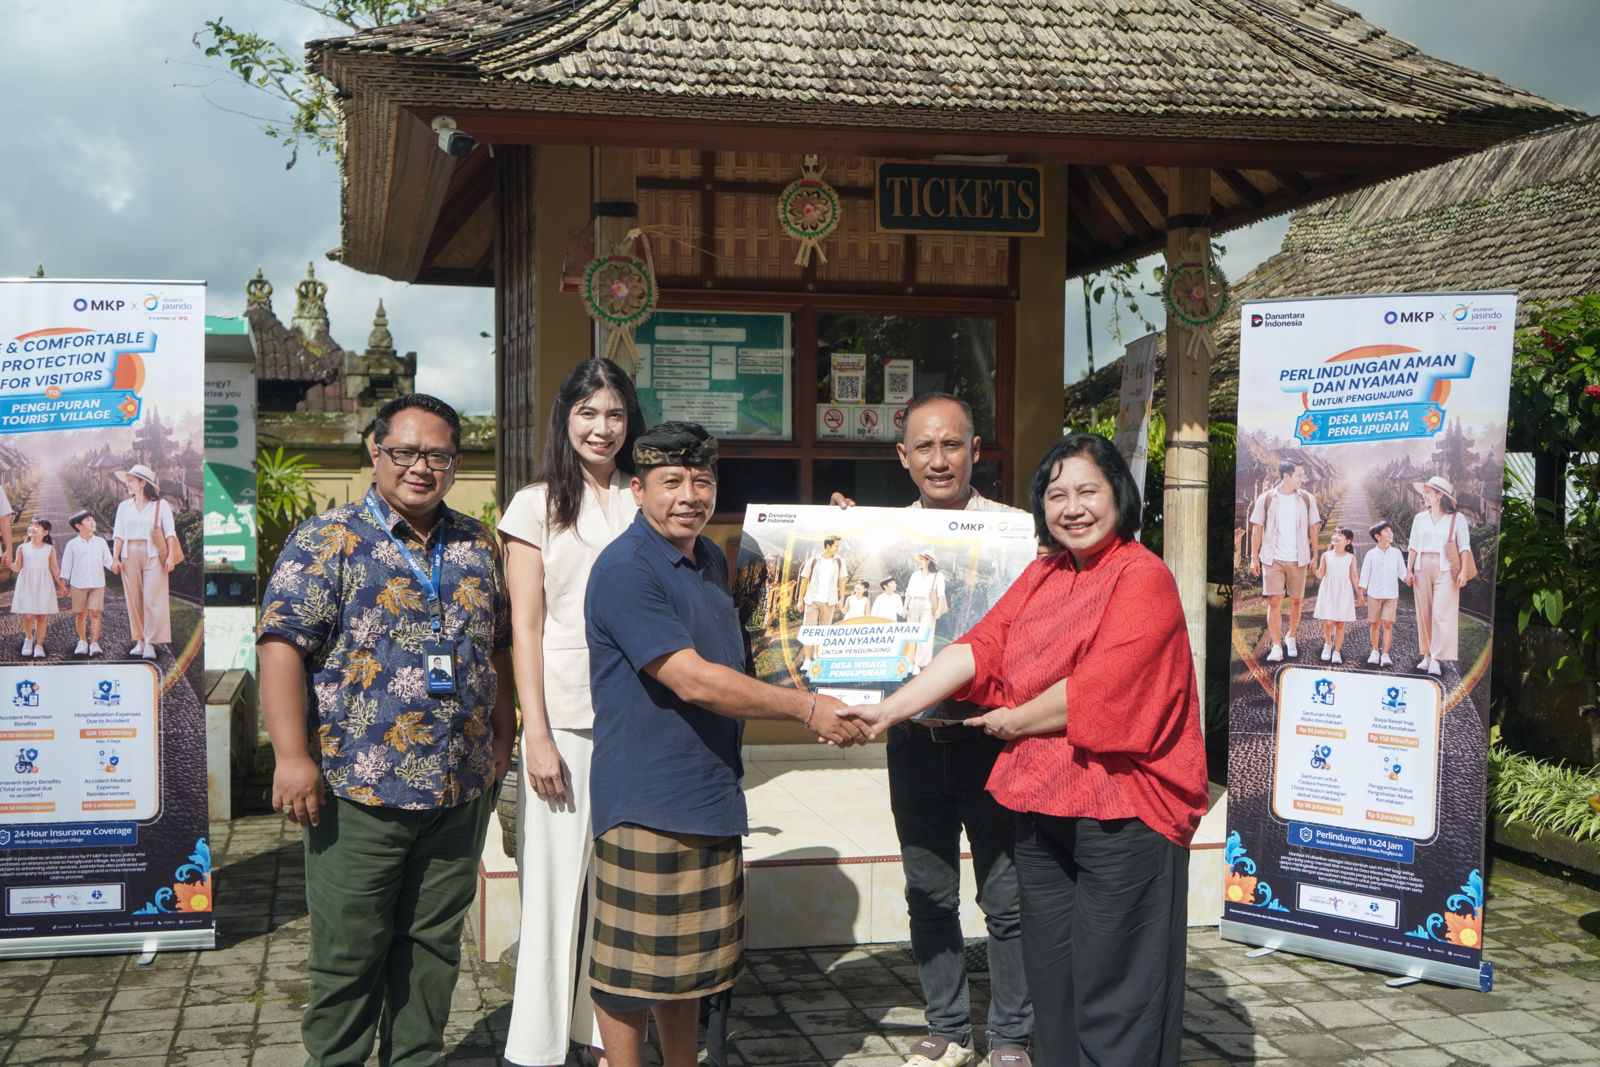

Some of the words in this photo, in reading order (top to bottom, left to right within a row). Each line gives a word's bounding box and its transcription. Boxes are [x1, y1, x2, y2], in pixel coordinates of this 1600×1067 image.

[886, 176, 1034, 220] TICKETS
[90, 300, 125, 312] MKP
[1265, 312, 1304, 320] Danantara
[1401, 311, 1434, 323] MKP
[1472, 312, 1502, 320] jasindo
[6, 342, 18, 353] &
[24, 332, 144, 352] COMFORTABLE
[2, 351, 106, 372] PROTECTION
[1280, 358, 1401, 381] PERLINDUNGAN
[1404, 354, 1457, 368] AMAN
[0, 377, 30, 389] FOR
[34, 370, 102, 387] VISITORS
[1312, 380, 1344, 394] DAN
[1349, 371, 1419, 390] NYAMAN
[1312, 396, 1343, 407] UNTUK
[1345, 388, 1413, 404] PENGUNJUNG
[12, 399, 100, 414] PENGLIPURAN
[2, 414, 55, 425] TOURIST
[61, 410, 111, 421] VILLAGE
[1328, 414, 1358, 425] DESA
[1362, 410, 1409, 422] WISATA
[1328, 422, 1410, 438] PENGLIPURAN
[960, 523, 984, 531] MKP
[802, 626, 884, 638] PERLINDUNGAN
[886, 626, 920, 634] AMAN
[823, 638, 847, 646] DAN
[848, 636, 895, 645] NYAMAN
[14, 830, 48, 838] 24-Hour
[50, 828, 91, 836] Insurance
[93, 827, 132, 836] Coverage
[1316, 830, 1366, 845] Perlindungan
[1369, 839, 1386, 848] 1x24
